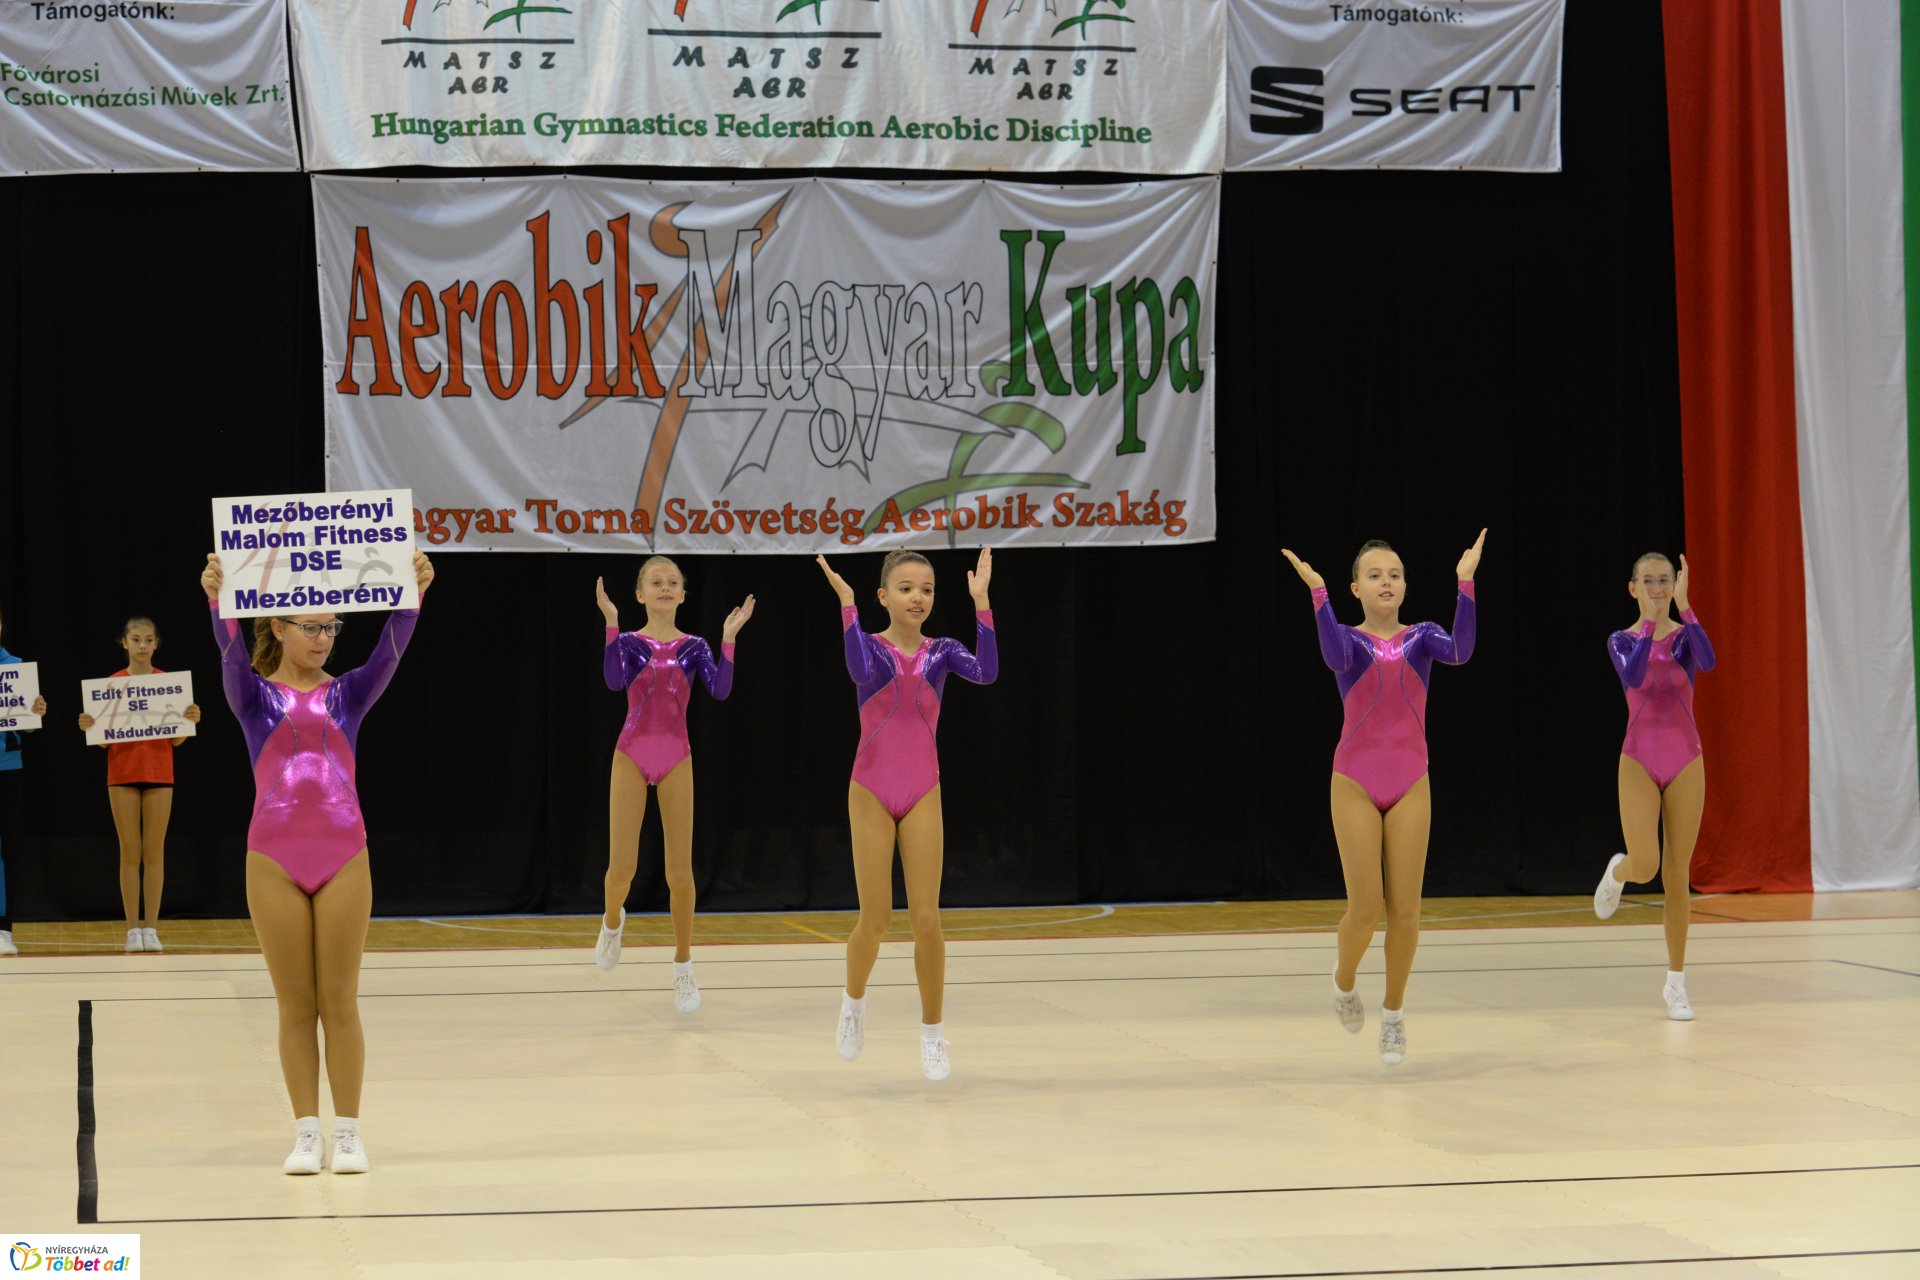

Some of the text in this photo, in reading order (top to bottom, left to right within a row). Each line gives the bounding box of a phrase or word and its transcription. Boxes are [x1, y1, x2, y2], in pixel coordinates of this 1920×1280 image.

[31, 1, 175, 22] Támogatónk:
[1330, 4, 1464, 25] Támogatónk:
[0, 62, 100, 84] Fővárosi
[4, 84, 285, 108] Csatornázási Művek Zrt.
[1350, 85, 1535, 116] SEAT
[371, 112, 1152, 147] Hungarian Gymnastics Federation Aerobic Discipline
[335, 210, 1205, 468] Aerobik Magyar Kupa
[231, 497, 394, 525] Mezőberényi
[525, 499, 654, 535] Torna
[664, 497, 865, 545] Szövetség
[873, 494, 1043, 533] Aerobik
[1051, 490, 1187, 537] Szakág
[220, 524, 408, 551] Malom Fitness
[290, 549, 343, 573] DSE
[234, 583, 404, 610] Mezőberény
[91, 684, 183, 702] Edit Fitness
[128, 699, 149, 712] SE
[104, 725, 178, 741] Nádudvar
